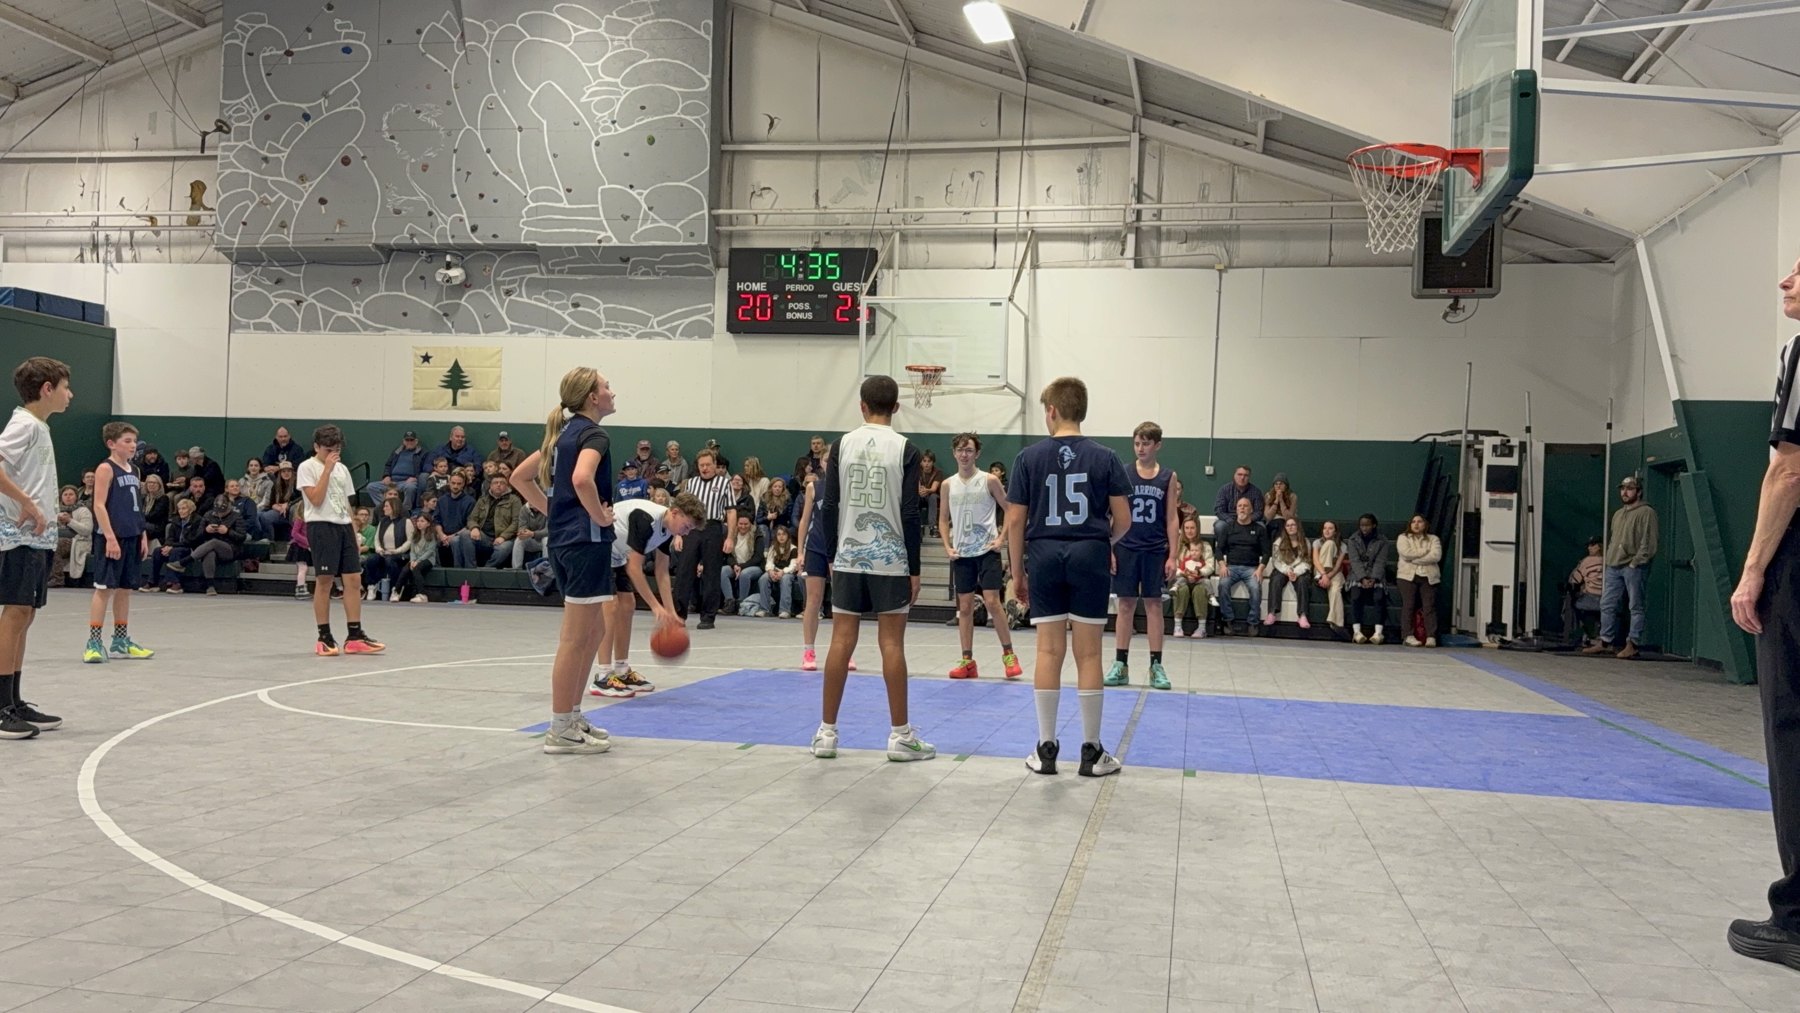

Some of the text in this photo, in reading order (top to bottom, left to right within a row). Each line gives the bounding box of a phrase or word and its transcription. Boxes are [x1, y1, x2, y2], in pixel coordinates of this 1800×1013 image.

[781, 253, 840, 280] 4:35
[736, 282, 767, 292] HOME
[832, 282, 867, 292] GUEST
[738, 294, 771, 320] 20
[788, 302, 812, 310] POSS.
[130, 486, 140, 512] 1
[848, 463, 887, 510] 23
[1046, 472, 1088, 526] 15
[1128, 485, 1164, 500] ARRIORS
[1132, 498, 1156, 524] 23
